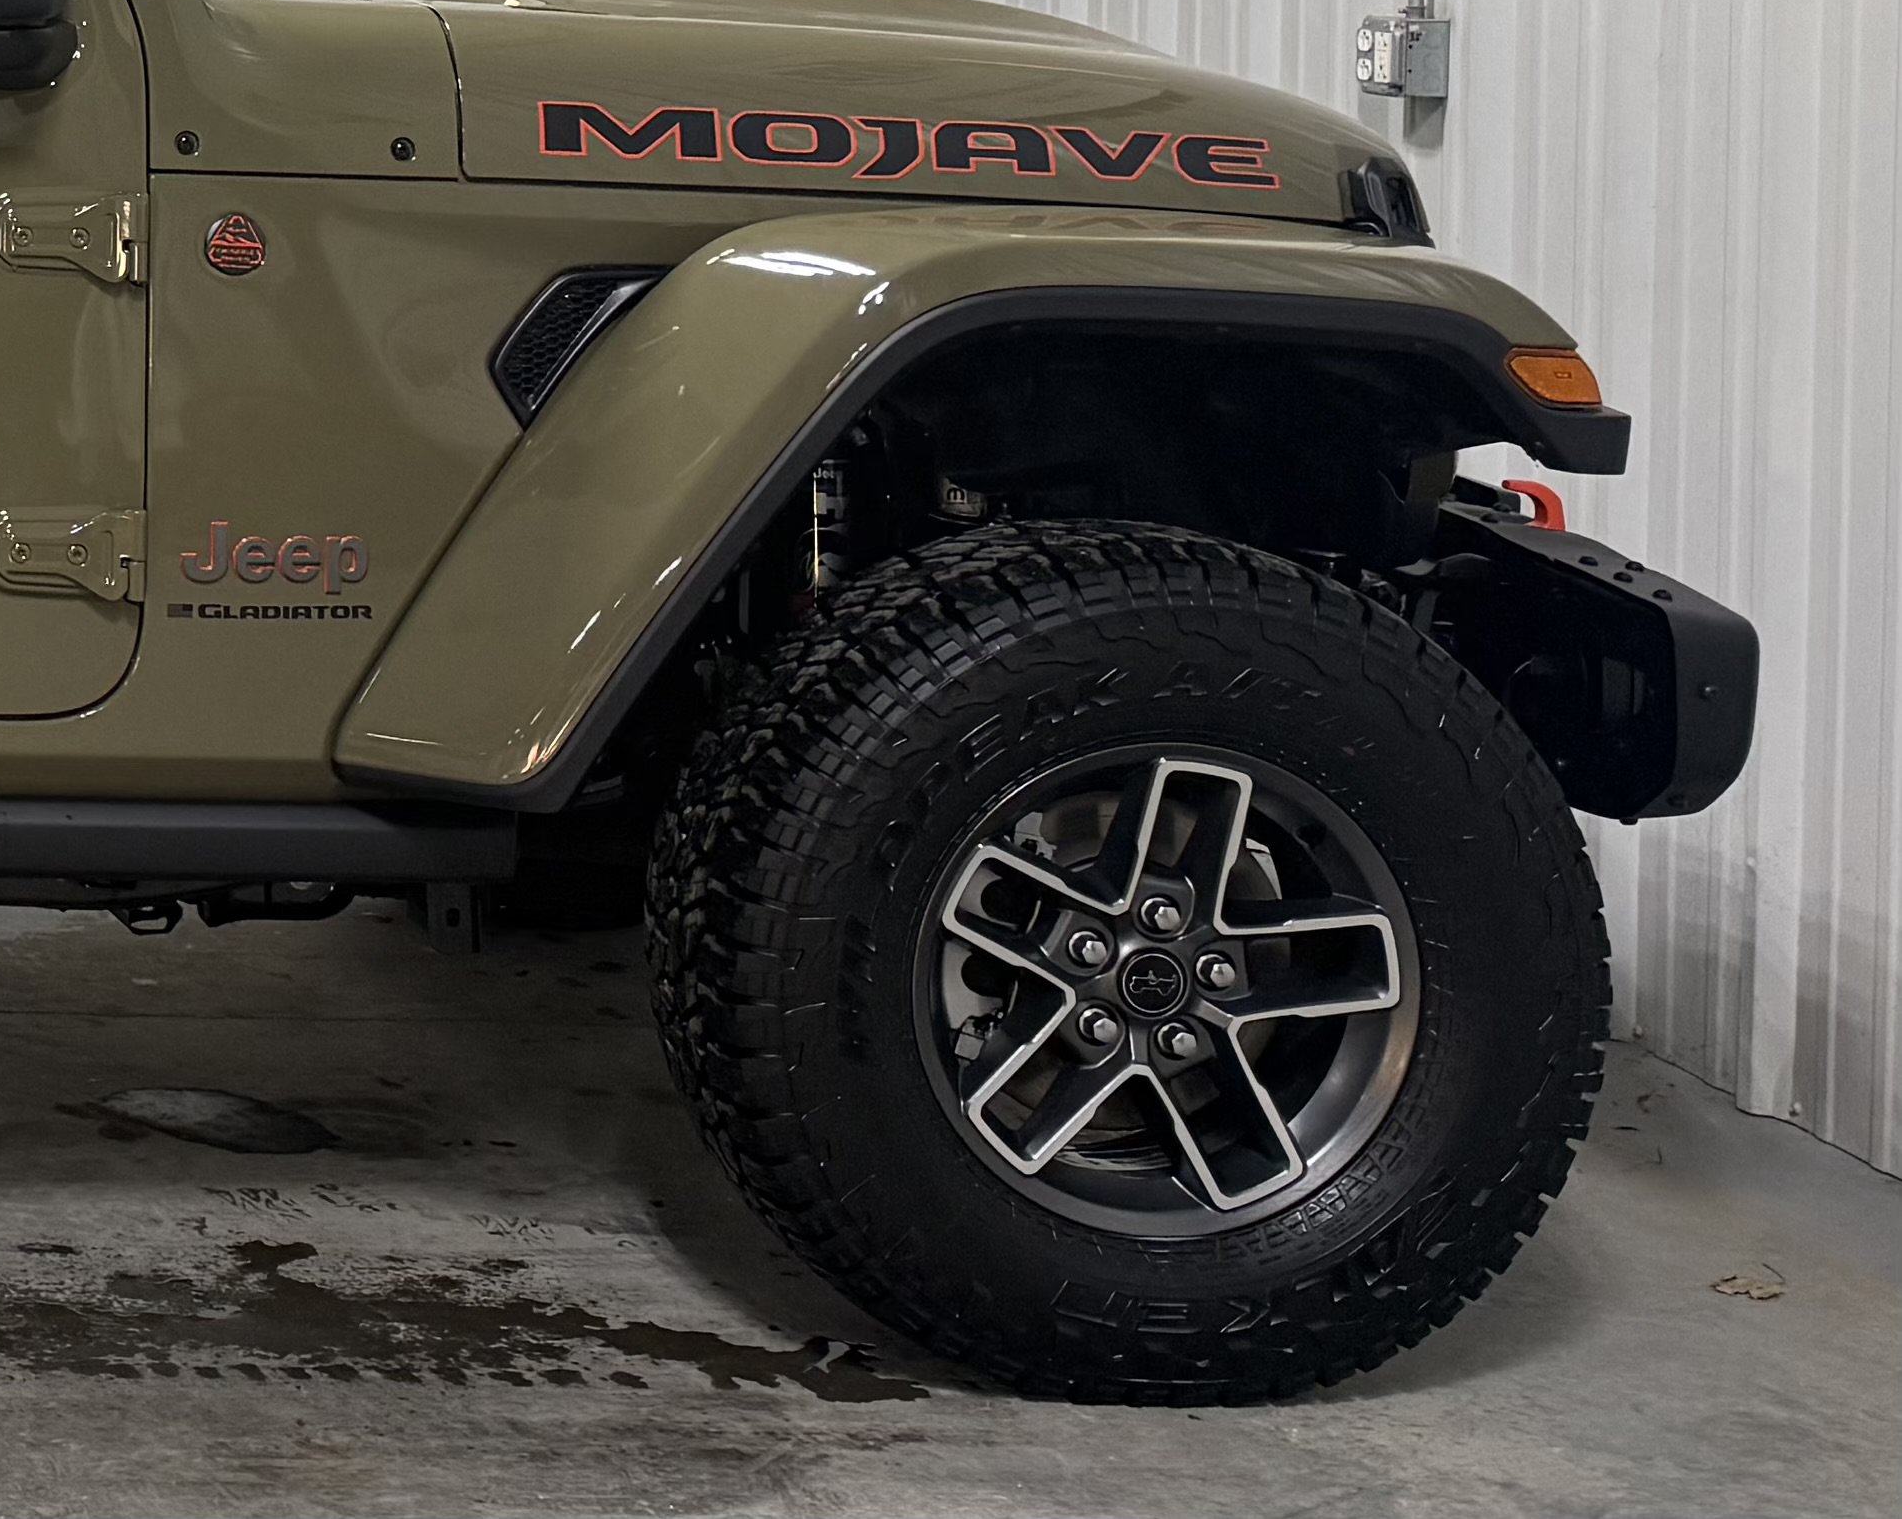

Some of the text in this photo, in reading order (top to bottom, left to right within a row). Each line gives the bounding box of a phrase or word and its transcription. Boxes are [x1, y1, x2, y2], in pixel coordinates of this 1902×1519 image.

[537, 100, 1280, 190] MOJAVE
[180, 521, 370, 595] Jeep
[198, 603, 373, 620] GLADIATOR
